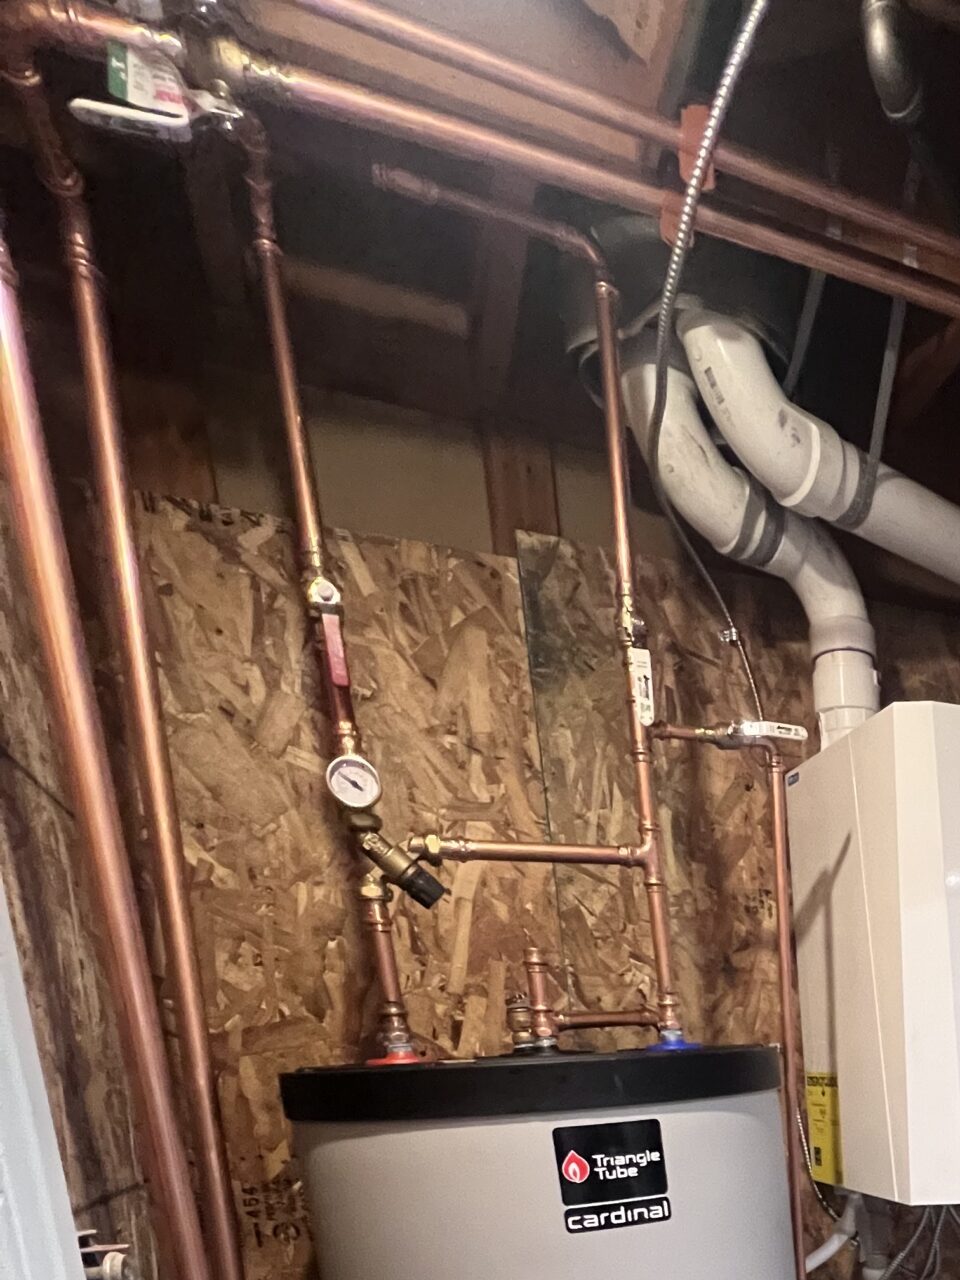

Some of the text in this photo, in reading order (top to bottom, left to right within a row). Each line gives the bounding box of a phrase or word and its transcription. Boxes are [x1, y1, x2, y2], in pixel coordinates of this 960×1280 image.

[592, 1150, 661, 1167] Triangle
[594, 1166, 639, 1180] Tube
[567, 1200, 669, 1229] cardinal
